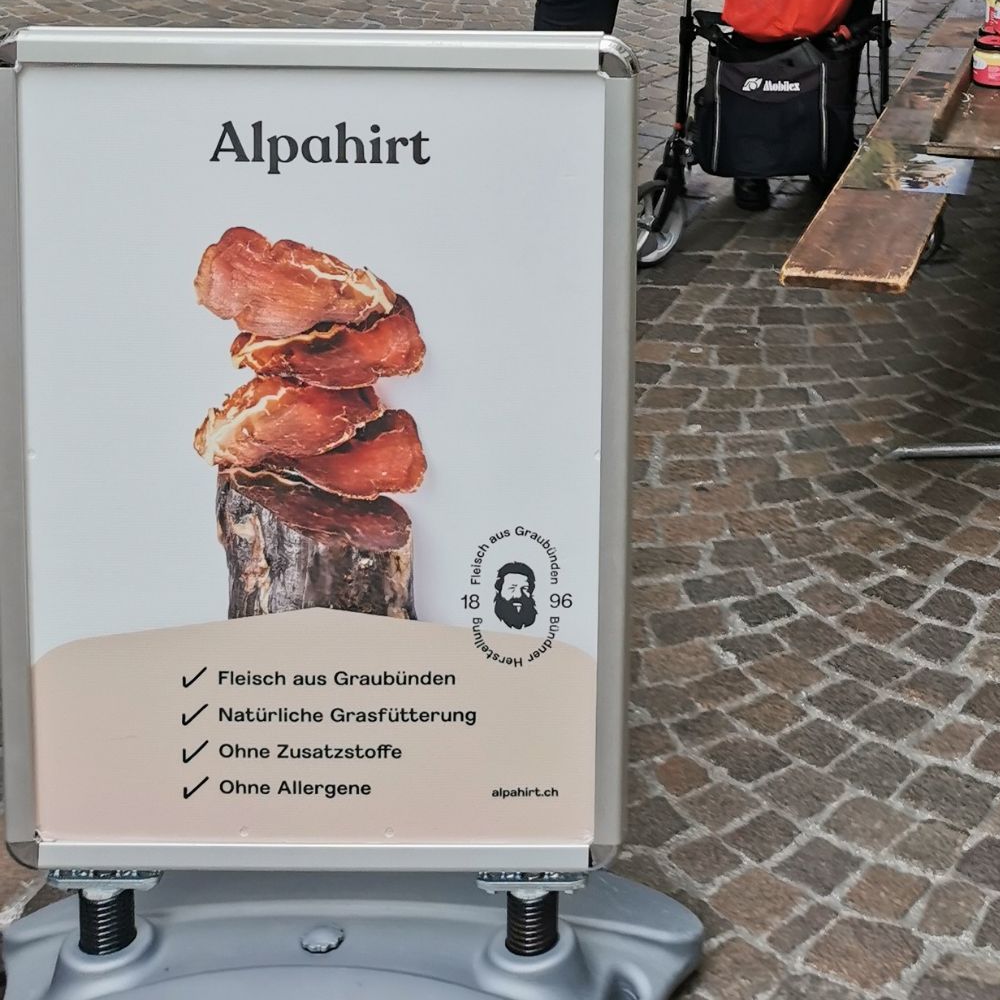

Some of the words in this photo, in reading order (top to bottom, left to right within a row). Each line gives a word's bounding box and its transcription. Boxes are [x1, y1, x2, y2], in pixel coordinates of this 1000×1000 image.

[763, 79, 800, 91] Mobilex
[209, 120, 431, 174] Alpahirt
[471, 543, 489, 585] Fleisch
[489, 529, 511, 544] aus
[515, 526, 561, 585] Graubünden
[461, 594, 480, 609] 18
[549, 593, 573, 609] 96
[472, 617, 523, 668] Herstellung
[528, 616, 560, 663] Bündner
[218, 671, 286, 686] Fleisch
[293, 674, 327, 686] aus
[334, 671, 456, 686] Graubünden
[218, 708, 323, 723] Natürliche
[330, 707, 477, 726] Grasfütterung
[219, 744, 270, 759] Ohne
[277, 744, 402, 759] Zusatzstoffe
[219, 780, 270, 795] Ohne
[277, 780, 371, 799] Allergene
[491, 787, 559, 799] alpahirt.ch
